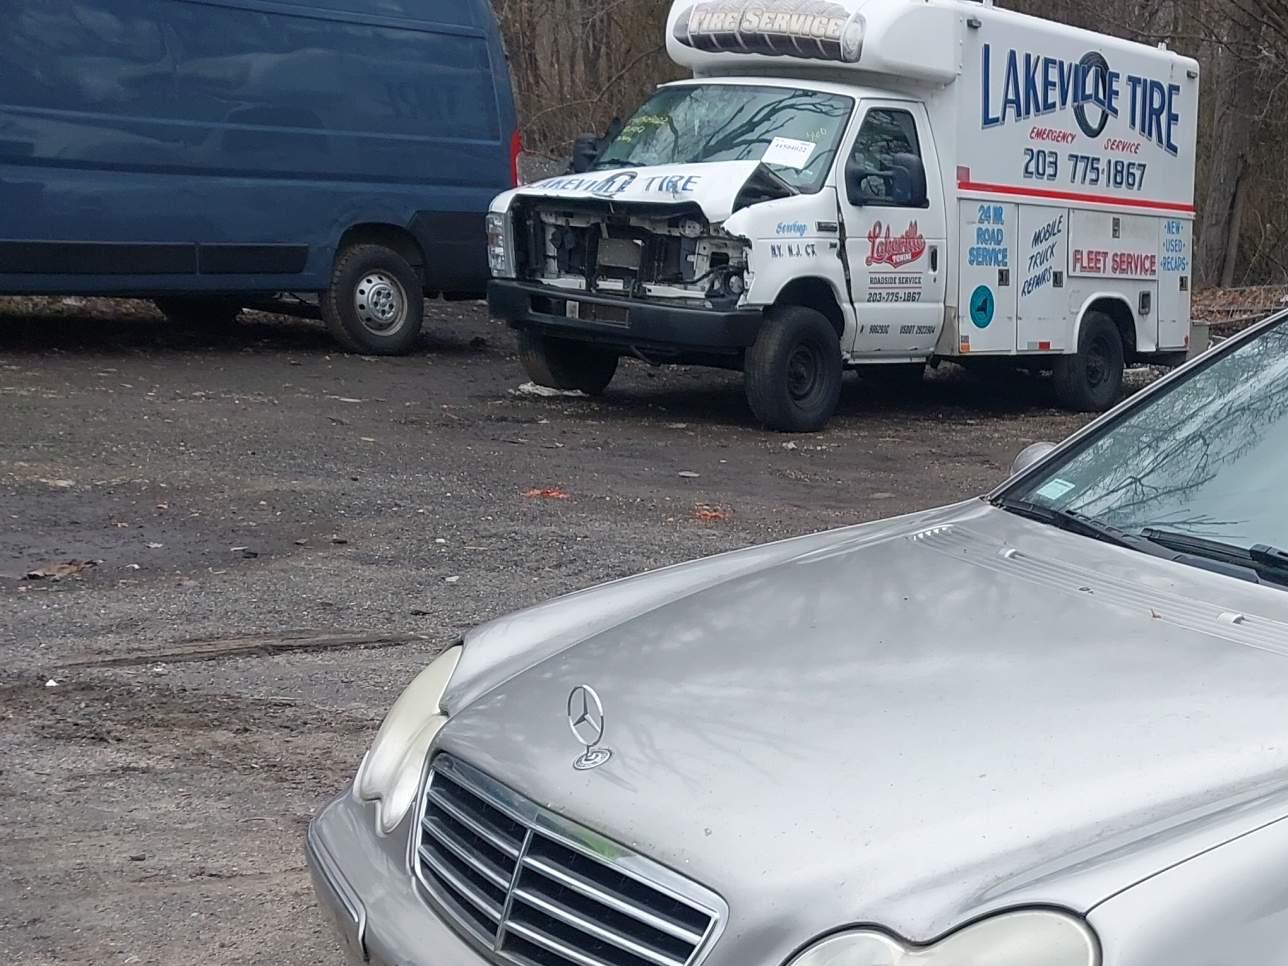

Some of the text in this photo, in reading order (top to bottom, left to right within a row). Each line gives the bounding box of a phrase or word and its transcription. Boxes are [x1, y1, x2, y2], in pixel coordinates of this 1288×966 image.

[690, 8, 846, 39] TIRE SERVICE
[981, 43, 1181, 158] LAKEVILLE TIRE
[1029, 126, 1141, 155] EMERGENCY SERVICE
[1023, 148, 1059, 181] 203
[644, 175, 702, 195] TIRE
[977, 204, 992, 225] 24
[976, 227, 1004, 247] ROAD
[1031, 214, 1064, 249] MOBILE
[967, 246, 1009, 268] SERVICE
[1027, 242, 1058, 274] TRUCK
[1072, 248, 1158, 276] FLEET SERVICE
[1021, 265, 1053, 297] REPAIRS
